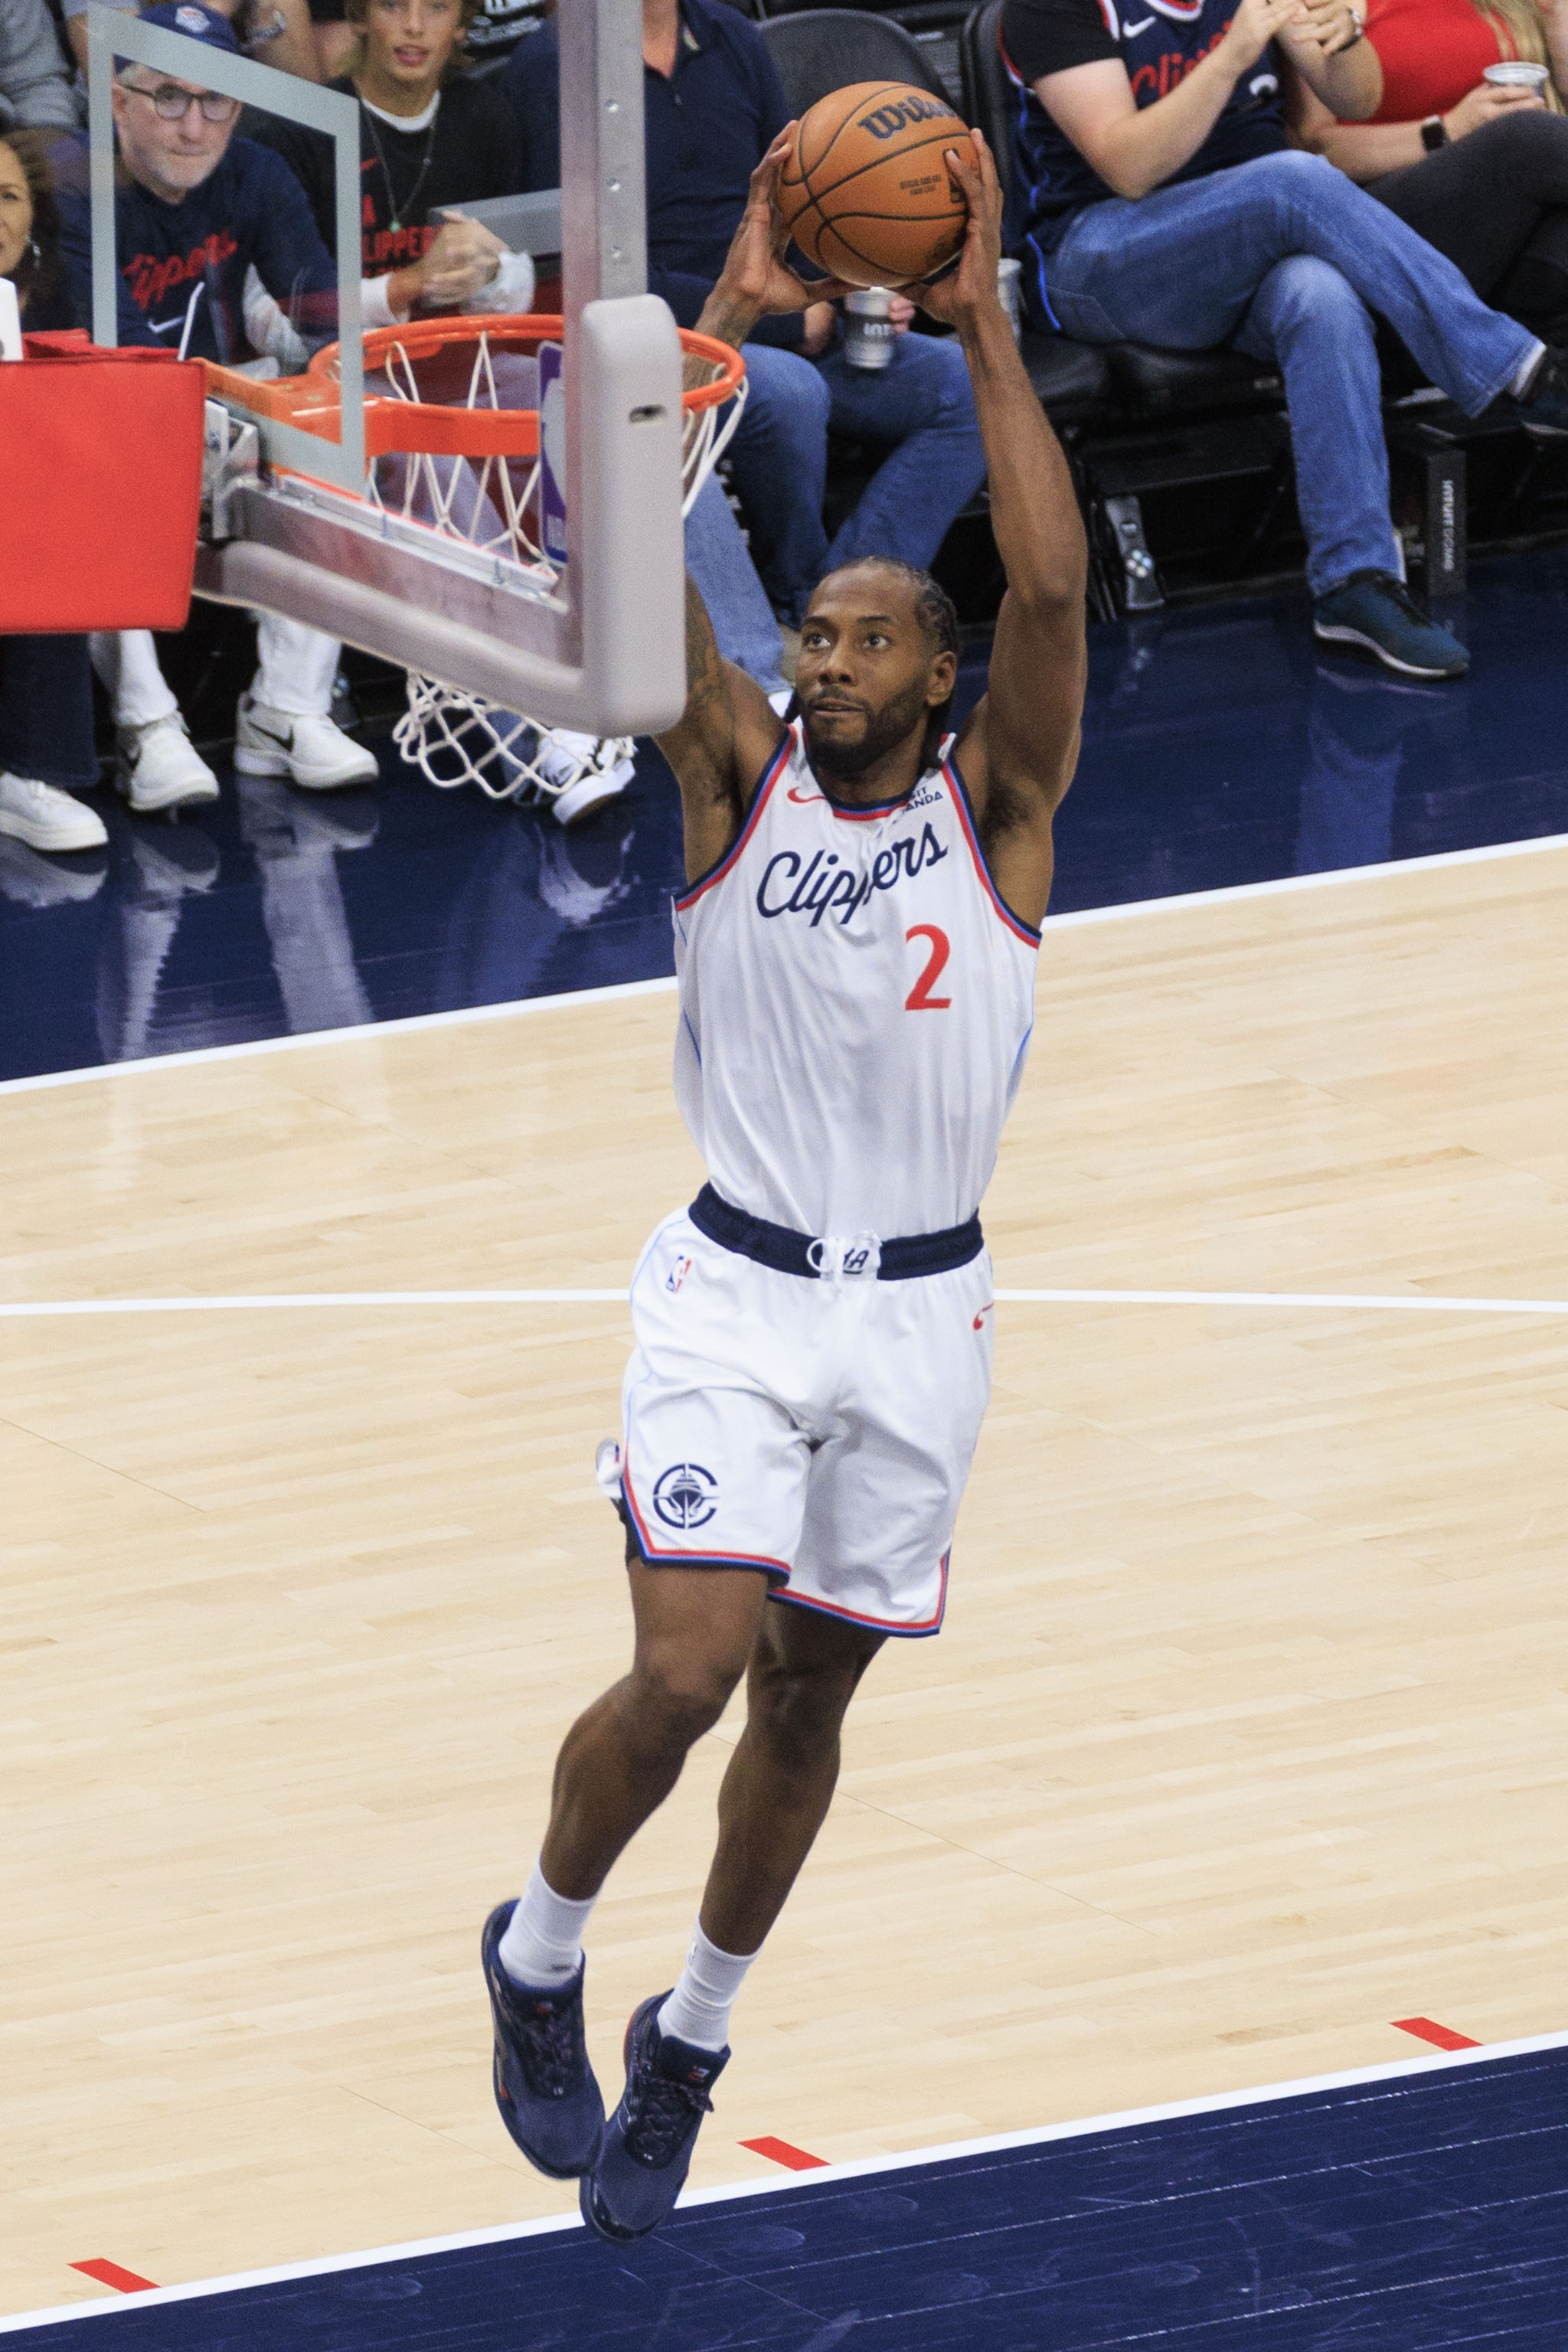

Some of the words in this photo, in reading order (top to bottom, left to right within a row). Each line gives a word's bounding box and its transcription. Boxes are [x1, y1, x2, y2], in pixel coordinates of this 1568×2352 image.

[902, 791, 943, 815] ANDA
[756, 822, 949, 927] Clippers
[904, 923, 952, 1011] 2
